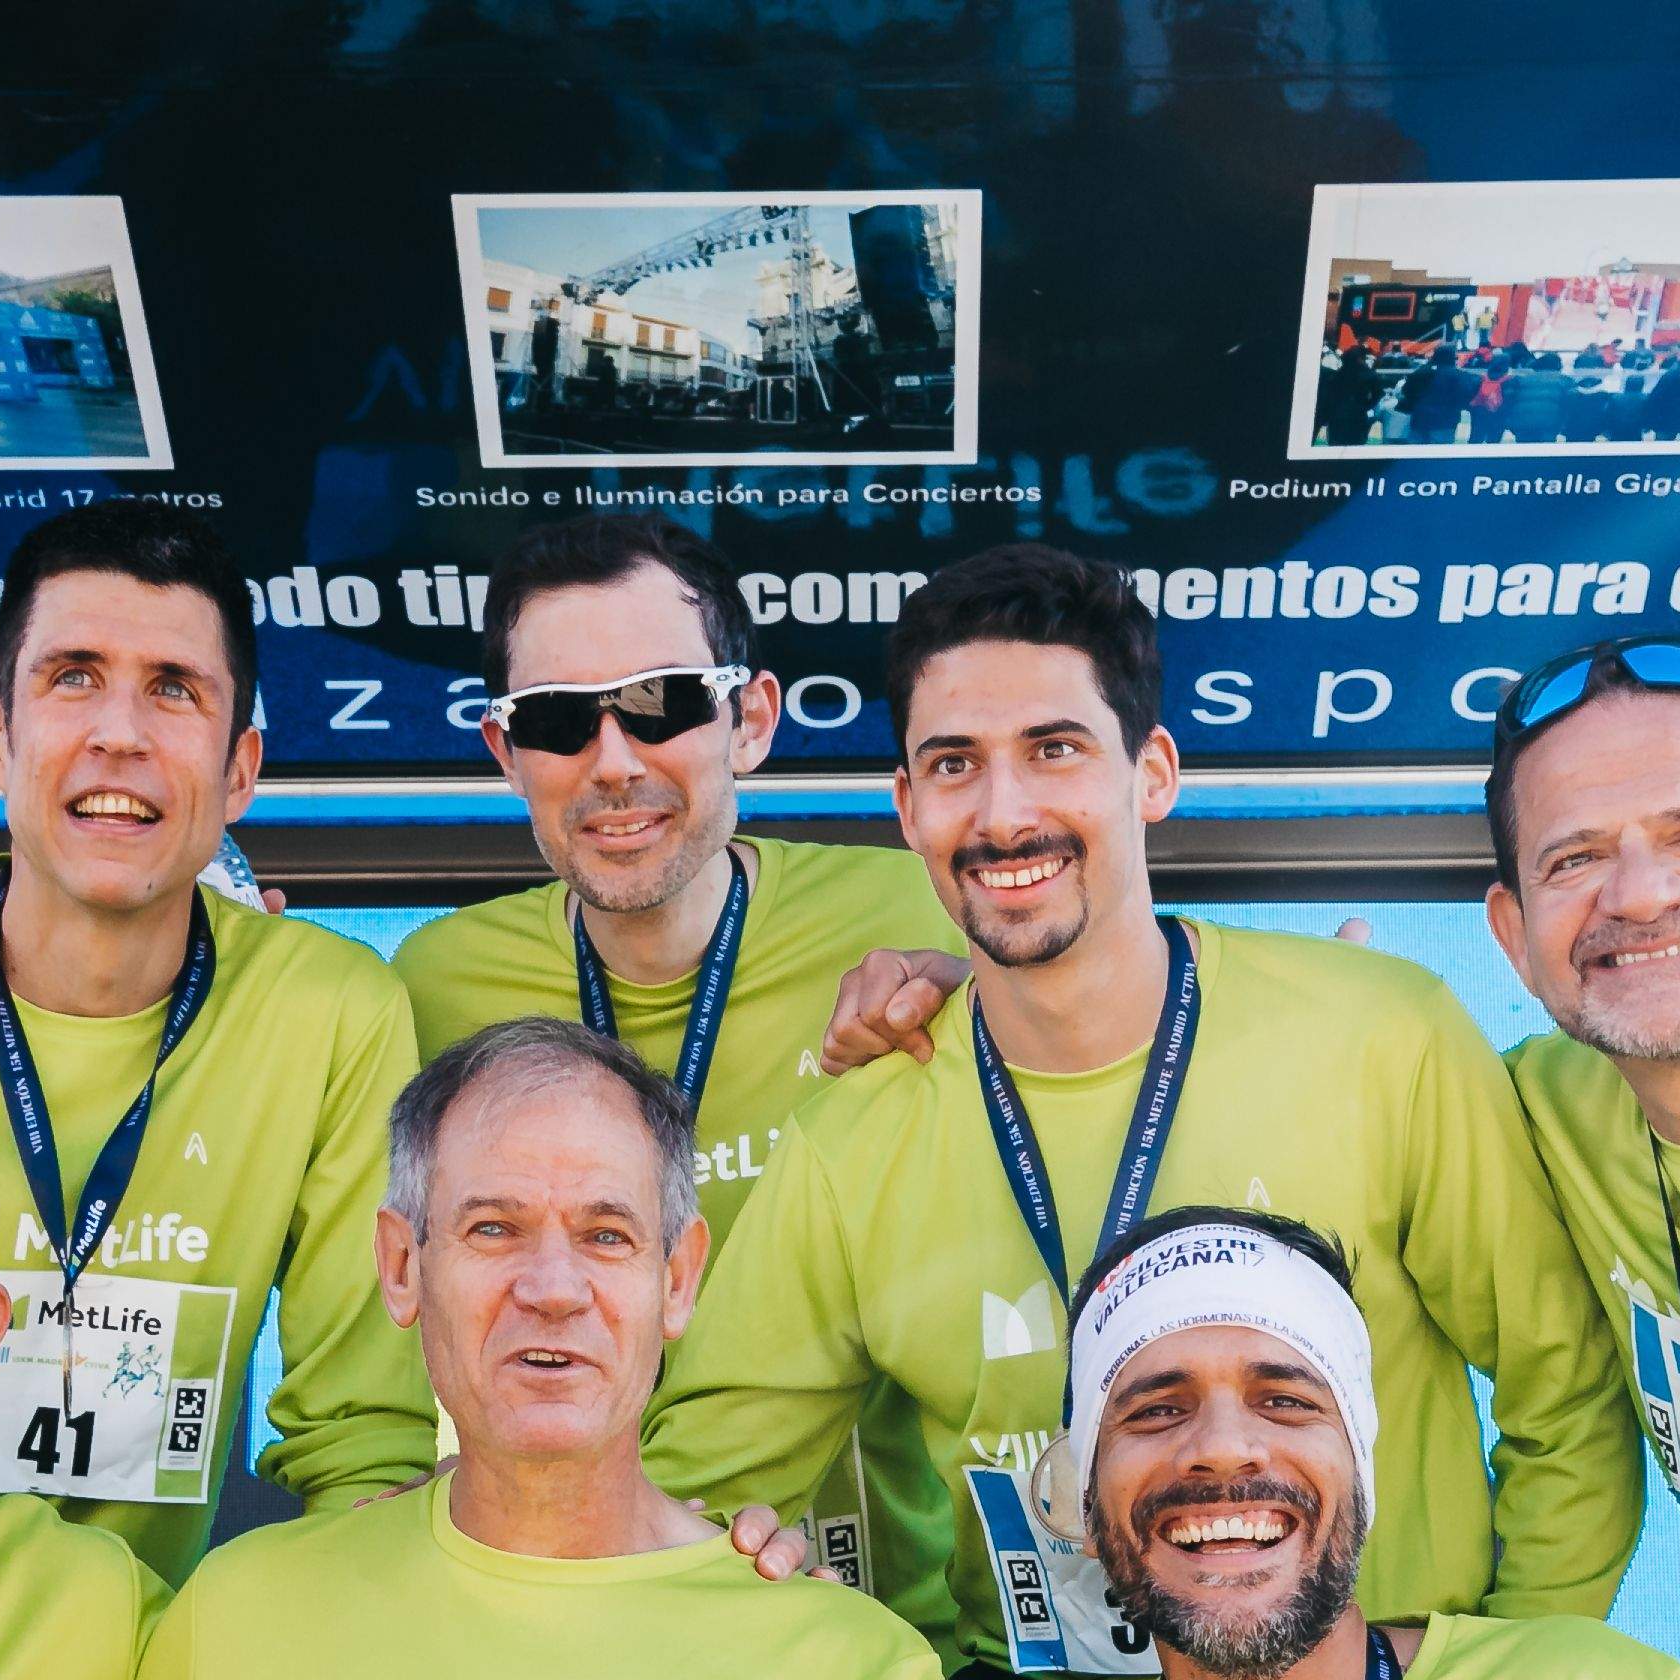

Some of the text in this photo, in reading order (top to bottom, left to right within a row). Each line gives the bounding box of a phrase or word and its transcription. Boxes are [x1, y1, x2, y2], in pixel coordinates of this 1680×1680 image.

[63, 490, 96, 508] 17
[416, 483, 1043, 511] Sonido e Iluminación para Conciertos
[1229, 475, 1352, 500] Podium
[1366, 478, 1386, 497] II
[1399, 481, 1458, 498] con
[1472, 473, 1601, 498] Pantalla
[1438, 561, 1651, 624] para
[1184, 961, 1198, 1009] ACTIVA
[1164, 1009, 1189, 1064] MADRID
[1147, 1068, 1174, 1130] METLIFE
[1140, 1124, 1156, 1149] 15K
[1120, 1155, 1148, 1211] EDICIÓN
[14, 1213, 211, 1270] MtLife
[76, 1200, 108, 1255] MetLife
[38, 1302, 163, 1337] MetLife
[1094, 1250, 1234, 1335] VALLECANA
[1177, 1313, 1252, 1329] HORMONAS
[17, 1406, 96, 1477] 41
